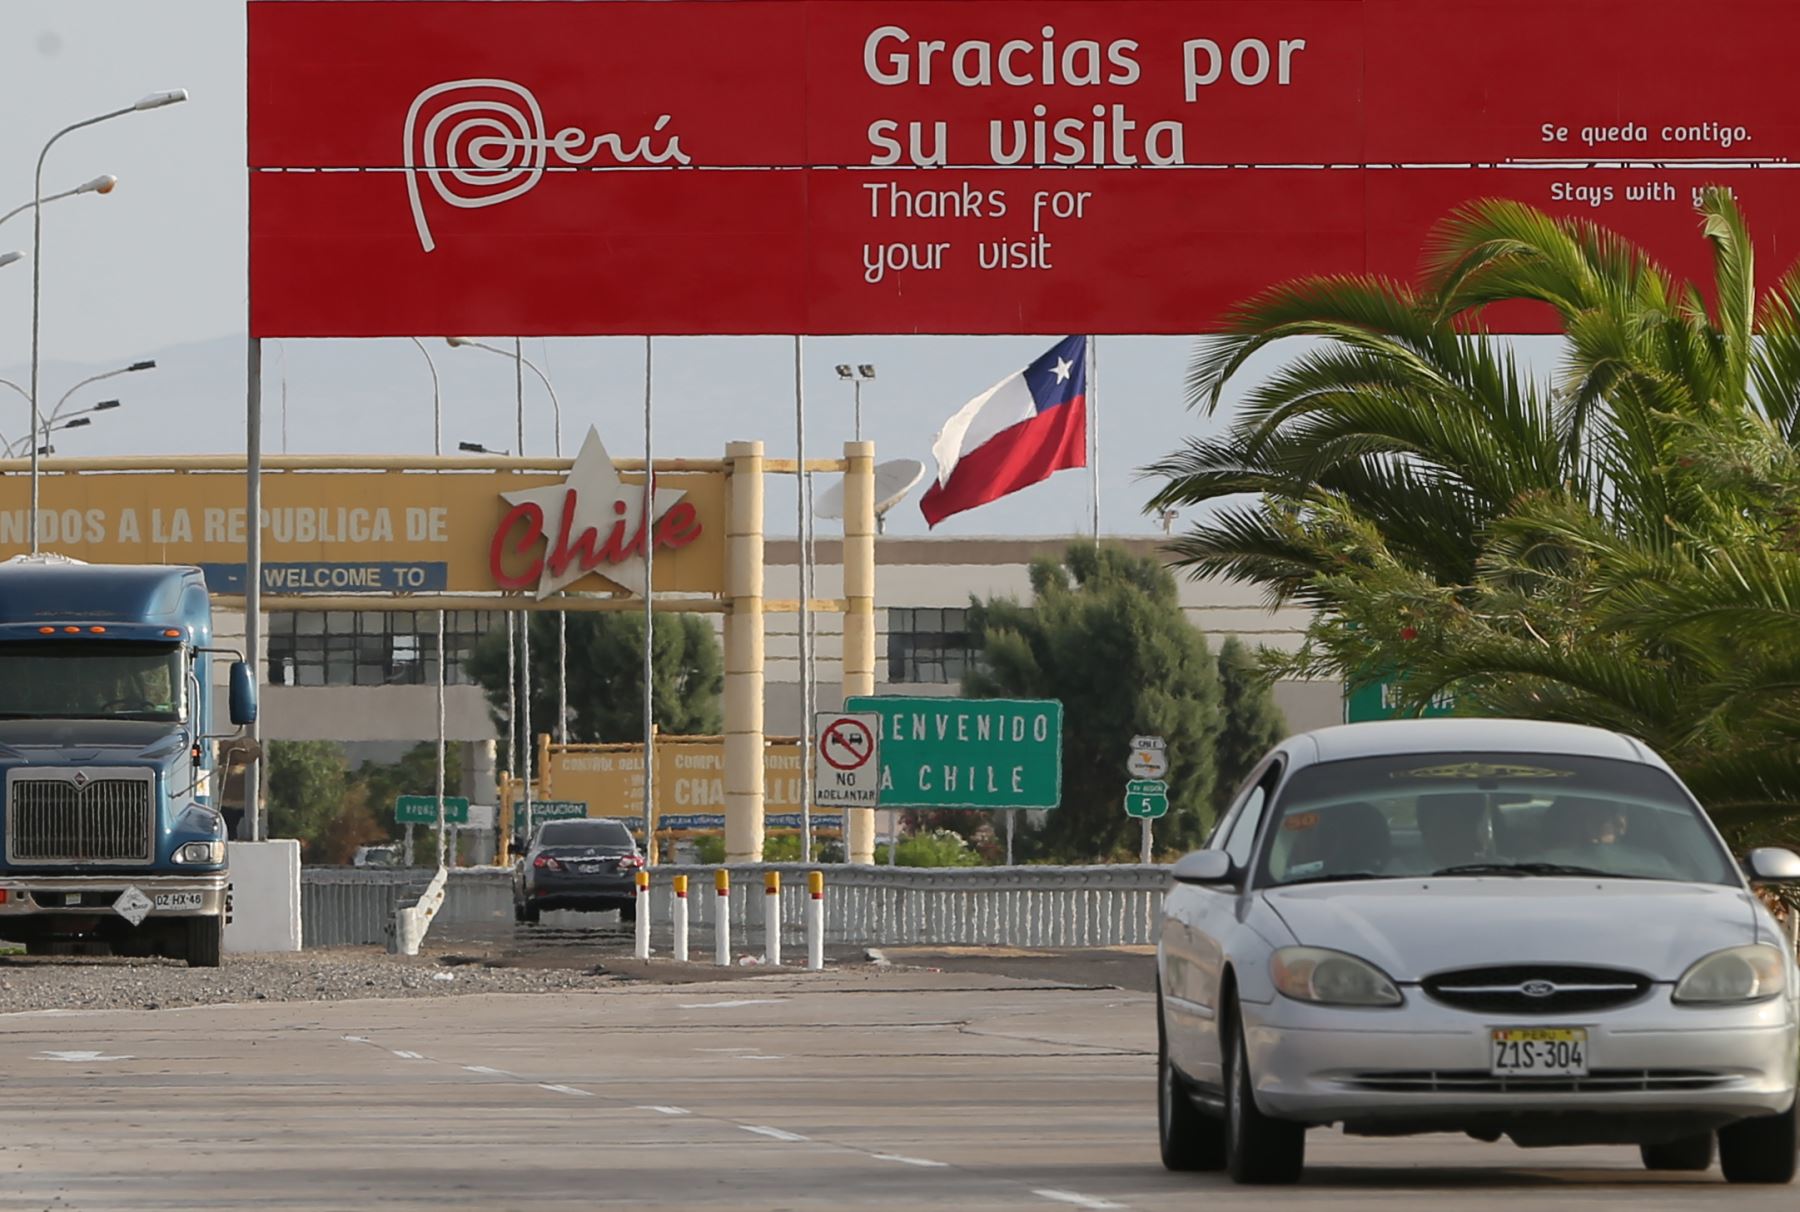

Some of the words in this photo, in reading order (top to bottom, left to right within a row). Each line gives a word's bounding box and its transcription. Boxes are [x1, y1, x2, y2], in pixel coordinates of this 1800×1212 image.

[863, 25, 1141, 87] Gracias
[1183, 38, 1306, 102] por
[868, 118, 948, 166] su
[989, 104, 1185, 166] visita
[1541, 123, 1569, 142] Se
[1581, 122, 1648, 146] queda
[1661, 122, 1752, 148] contigo.
[403, 78, 691, 253] Perú
[862, 181, 1007, 218] Thanks
[1033, 190, 1091, 233] for
[1551, 182, 1614, 207] Stays
[1626, 182, 1676, 201] with
[1691, 186, 1738, 207] y.
[862, 240, 951, 283] your
[978, 233, 1053, 270] visit
[117, 507, 141, 543] A
[152, 507, 193, 543] LA
[406, 507, 449, 542] DE
[264, 568, 382, 588] WELCOME
[392, 568, 425, 587] TO
[879, 714, 1047, 742] IENVENIDO
[836, 773, 856, 786] NO
[880, 764, 894, 790] A
[919, 764, 1023, 793] CHILE
[818, 790, 875, 801] ADELANTAR
[1142, 798, 1152, 813] 5
[1496, 1041, 1582, 1068] Z1S-304
